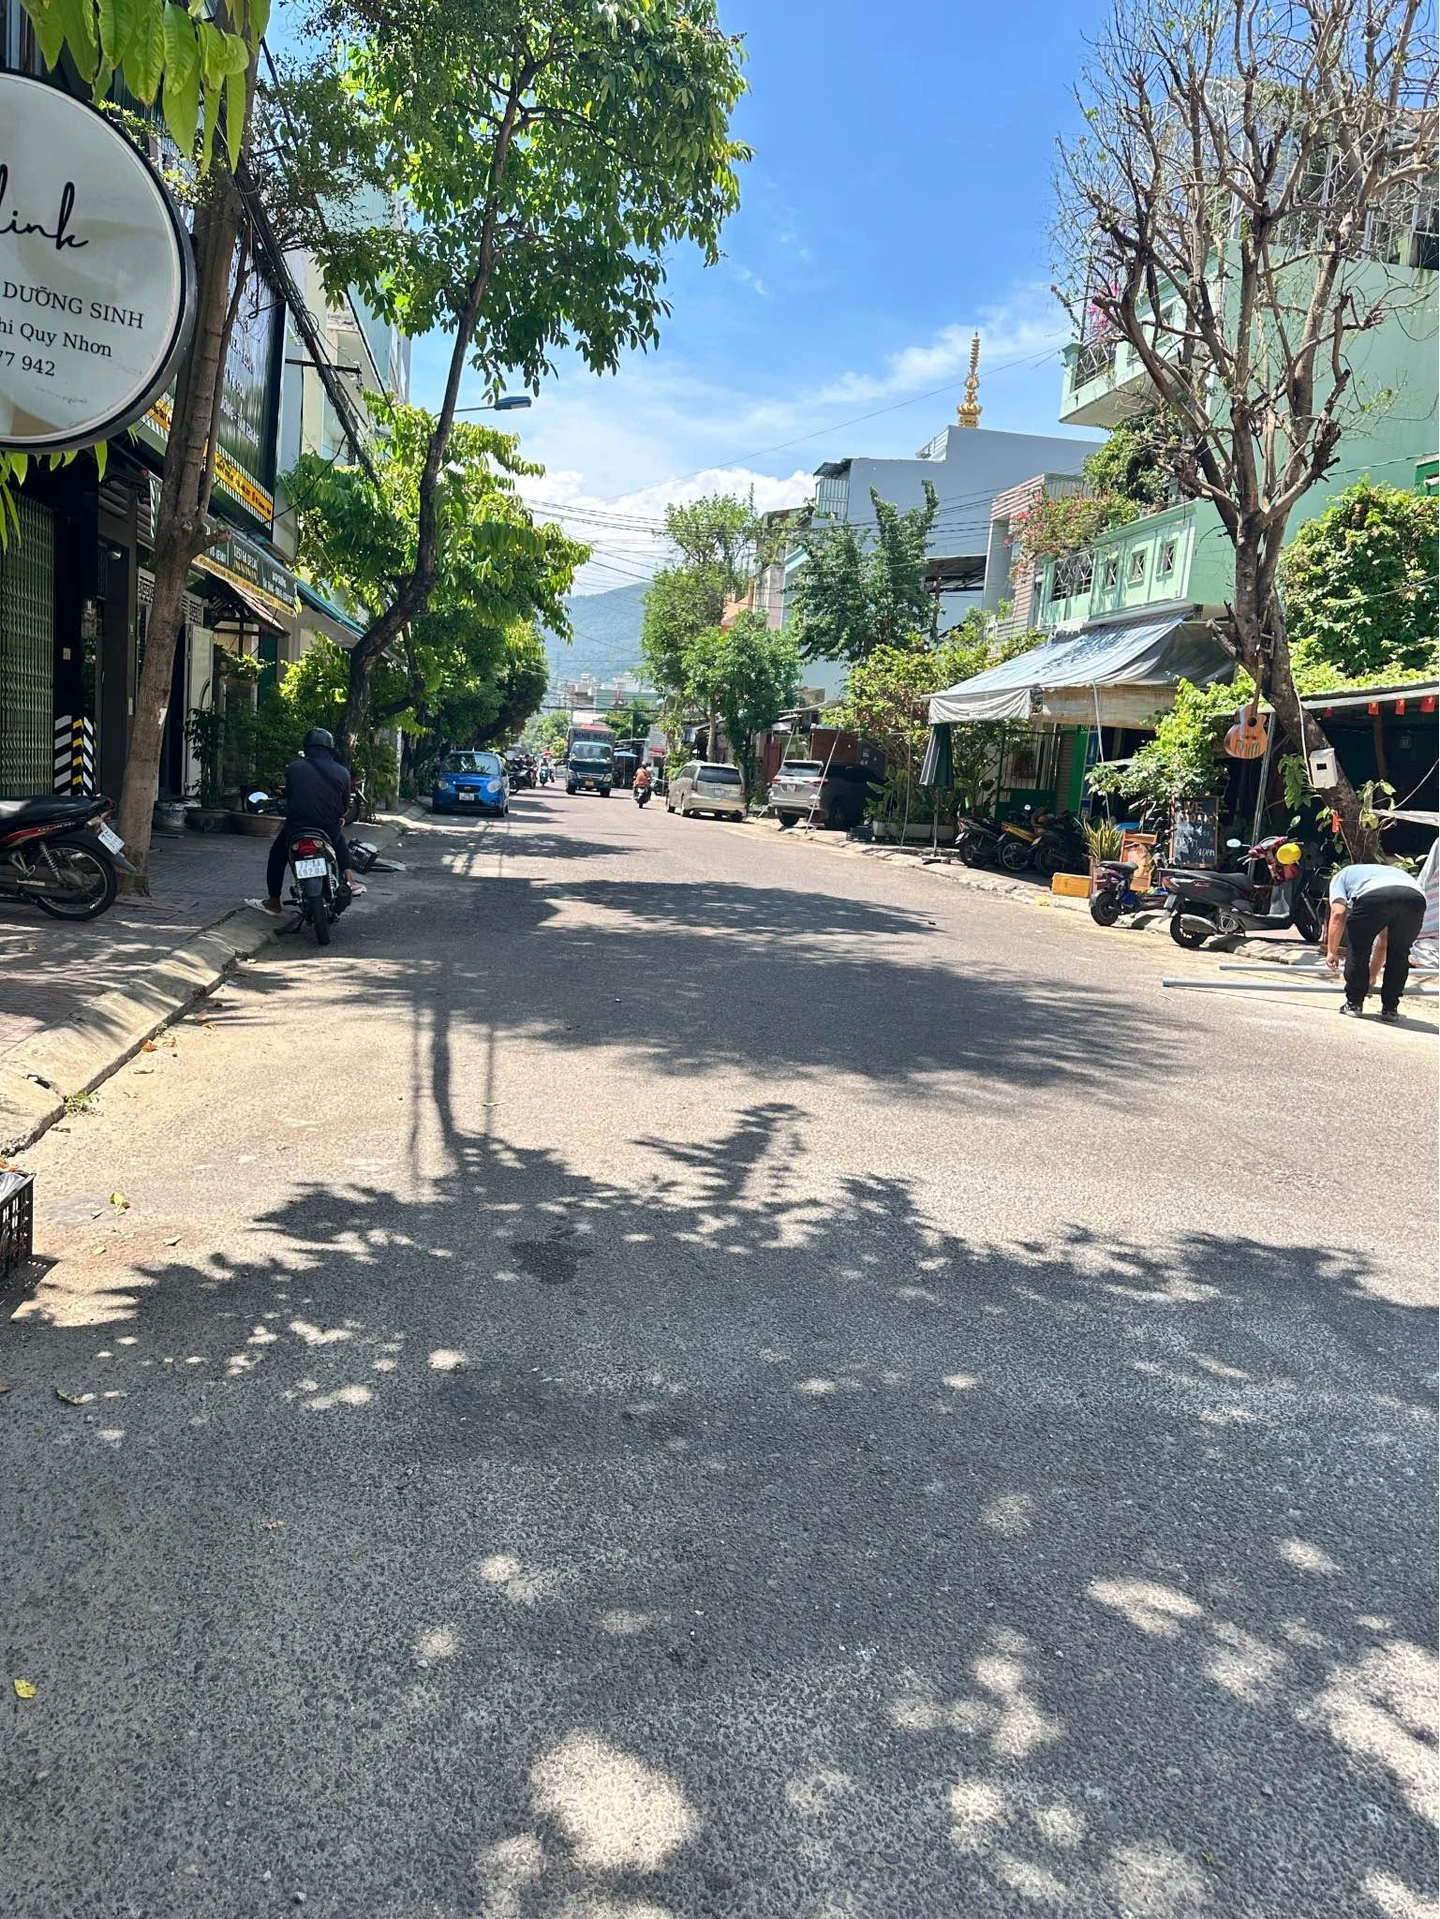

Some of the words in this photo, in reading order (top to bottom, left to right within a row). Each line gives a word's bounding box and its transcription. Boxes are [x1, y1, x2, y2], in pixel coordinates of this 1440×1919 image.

[3, 281, 83, 314] DƯỠNG
[90, 302, 144, 329] SINH
[20, 322, 57, 347] Quy
[62, 331, 112, 357] Nhơn
[22, 355, 55, 377] 942
